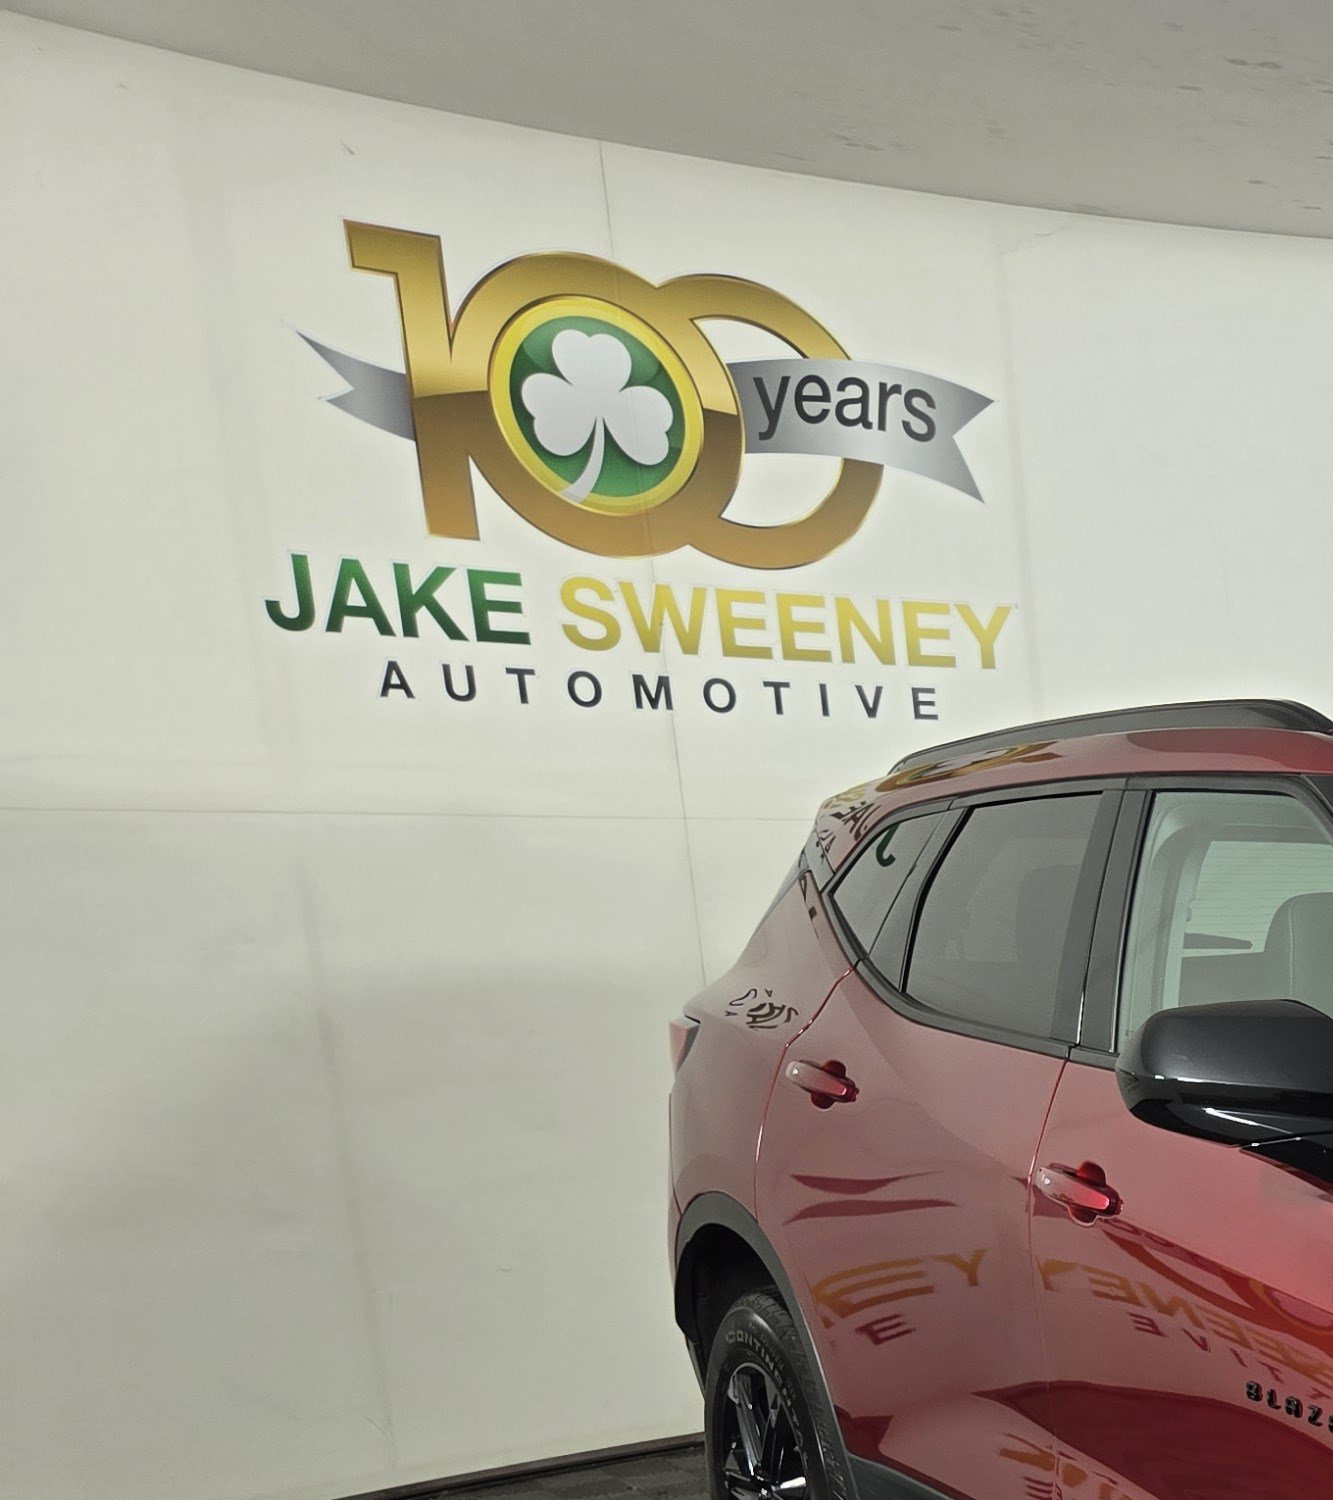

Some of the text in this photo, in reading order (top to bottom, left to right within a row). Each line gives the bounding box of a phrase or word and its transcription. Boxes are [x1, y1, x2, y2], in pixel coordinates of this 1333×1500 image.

[344, 220, 937, 569] 100 years
[265, 553, 1009, 670] JAKE SWEENEY
[380, 661, 939, 720] AUTOMOTIVE
